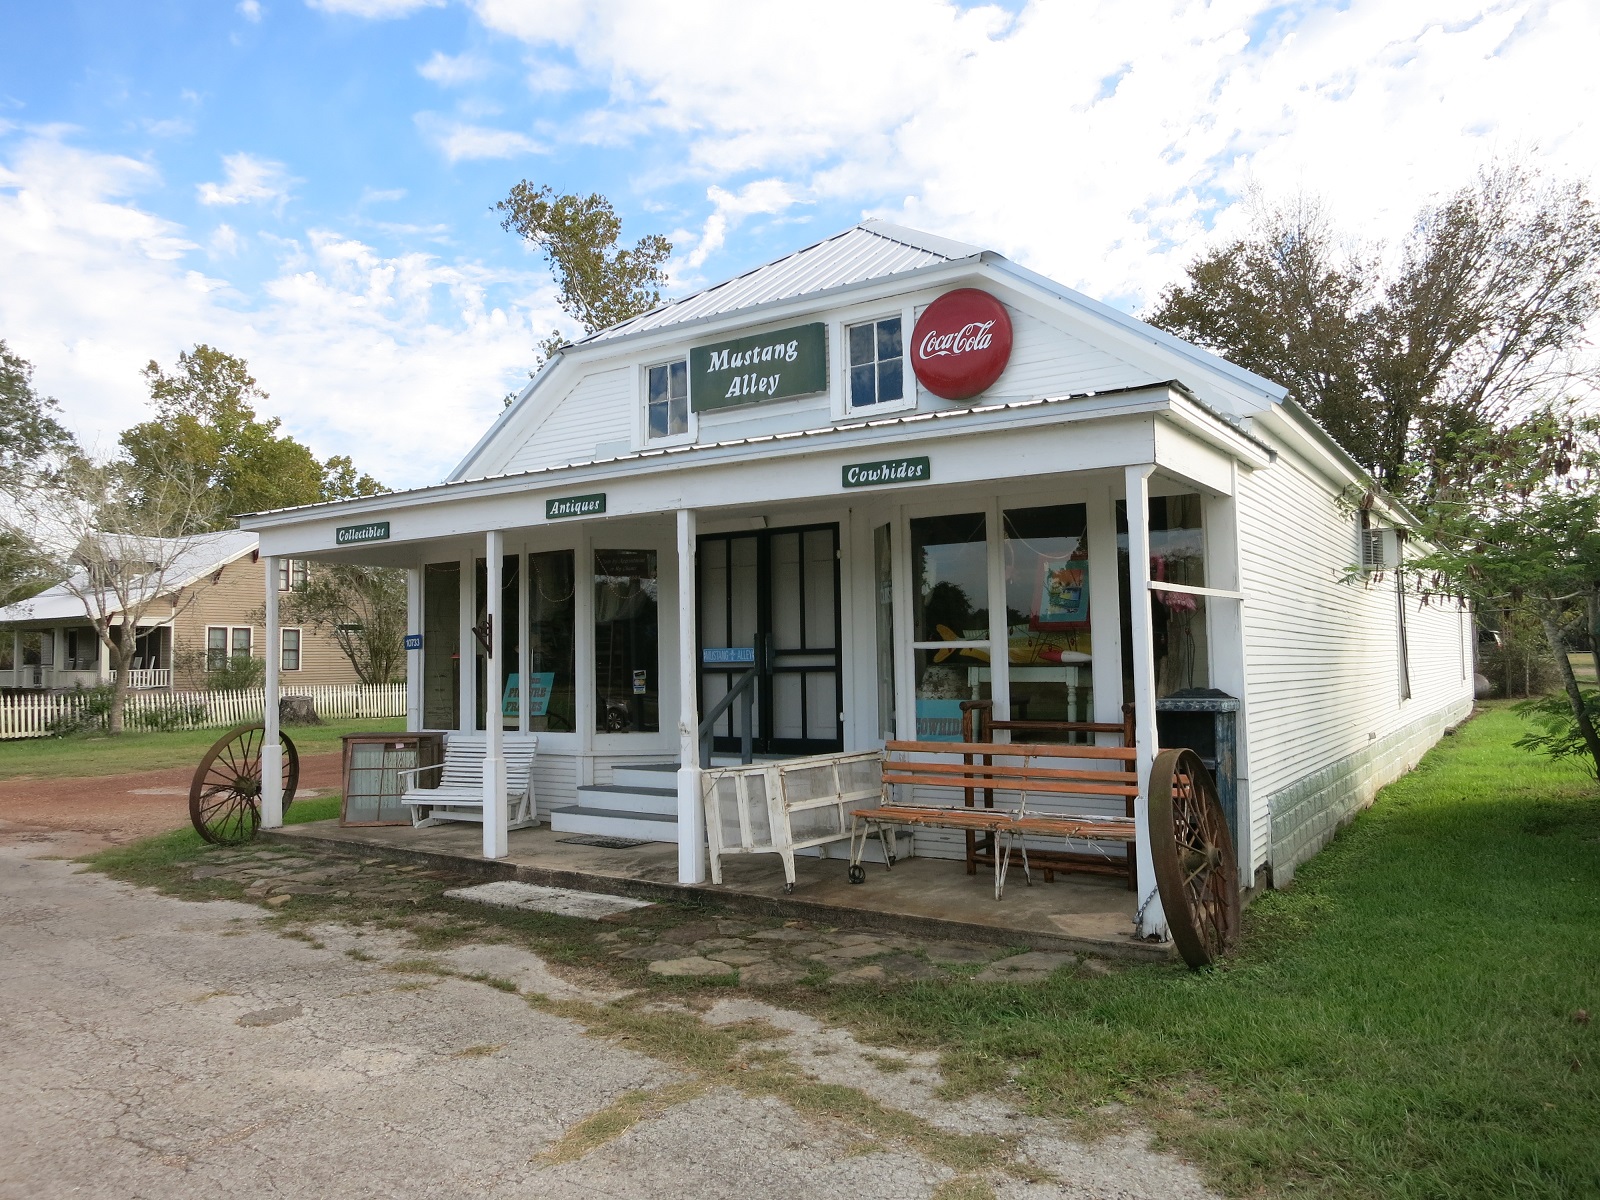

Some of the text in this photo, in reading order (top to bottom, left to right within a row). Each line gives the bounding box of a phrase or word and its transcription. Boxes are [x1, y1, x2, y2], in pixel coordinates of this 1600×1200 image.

[706, 339, 799, 373] Mustang
[724, 372, 781, 398] Alley
[847, 461, 923, 483] Cowhides
[549, 499, 600, 515] Antiques
[338, 525, 385, 542] Collectibles
[405, 638, 420, 647] 10733
